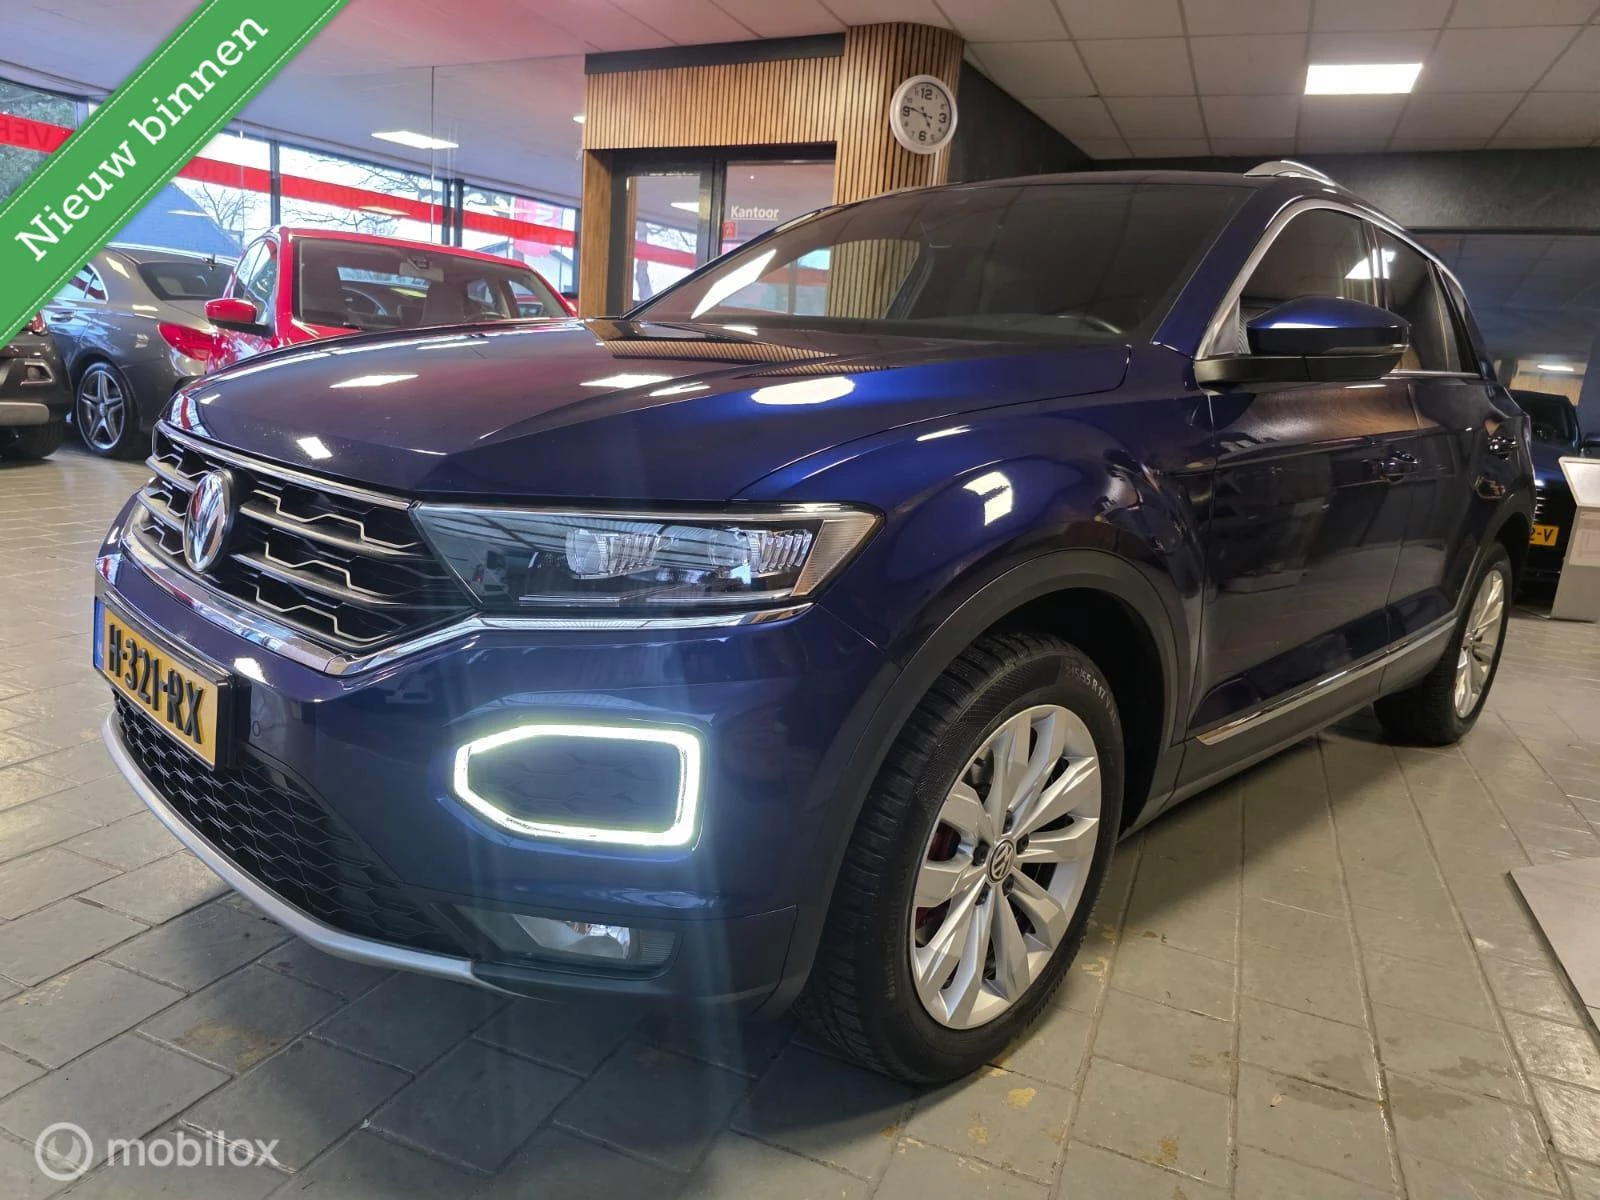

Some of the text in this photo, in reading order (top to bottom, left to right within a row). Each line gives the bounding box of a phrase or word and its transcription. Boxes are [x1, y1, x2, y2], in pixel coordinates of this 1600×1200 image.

[921, 87, 933, 100] 12
[903, 105, 910, 118] 9
[938, 112, 947, 124] 3
[918, 130, 927, 142] 6
[731, 205, 779, 219] Kantoor
[109, 623, 204, 745] H-321-RX
